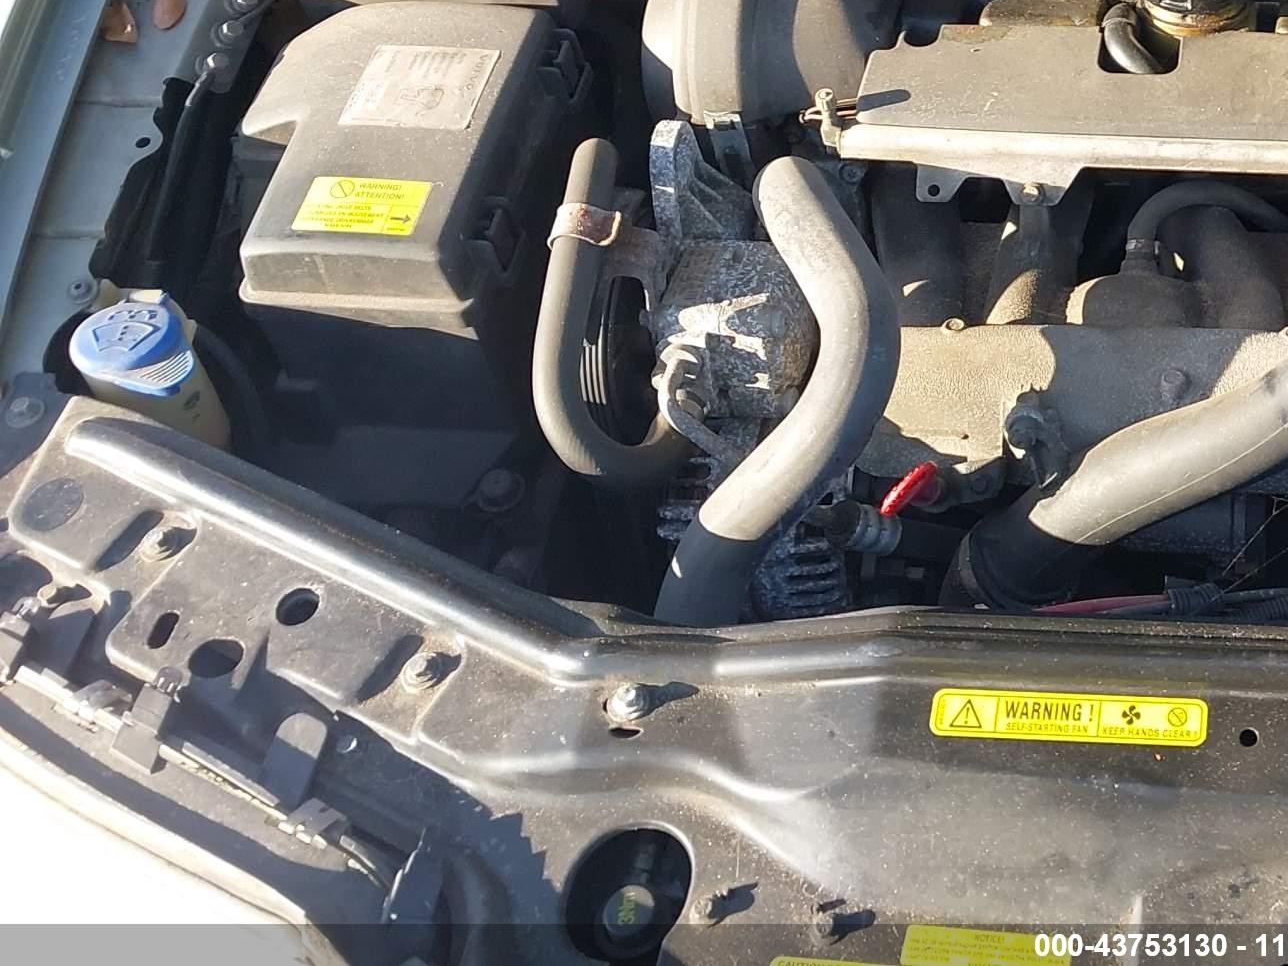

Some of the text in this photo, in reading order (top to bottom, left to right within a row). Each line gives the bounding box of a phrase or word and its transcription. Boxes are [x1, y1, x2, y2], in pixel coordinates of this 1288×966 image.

[464, 53, 489, 91] VOLVO
[359, 183, 402, 191] WARNING!
[354, 191, 405, 200] ATTENTION!
[1005, 700, 1082, 721] WARNING
[1006, 722, 1089, 733] SELF-STARTING FAN
[1102, 726, 1125, 736] KEEP
[1128, 728, 1160, 738] HANDS
[1162, 730, 1191, 738] CLEAR
